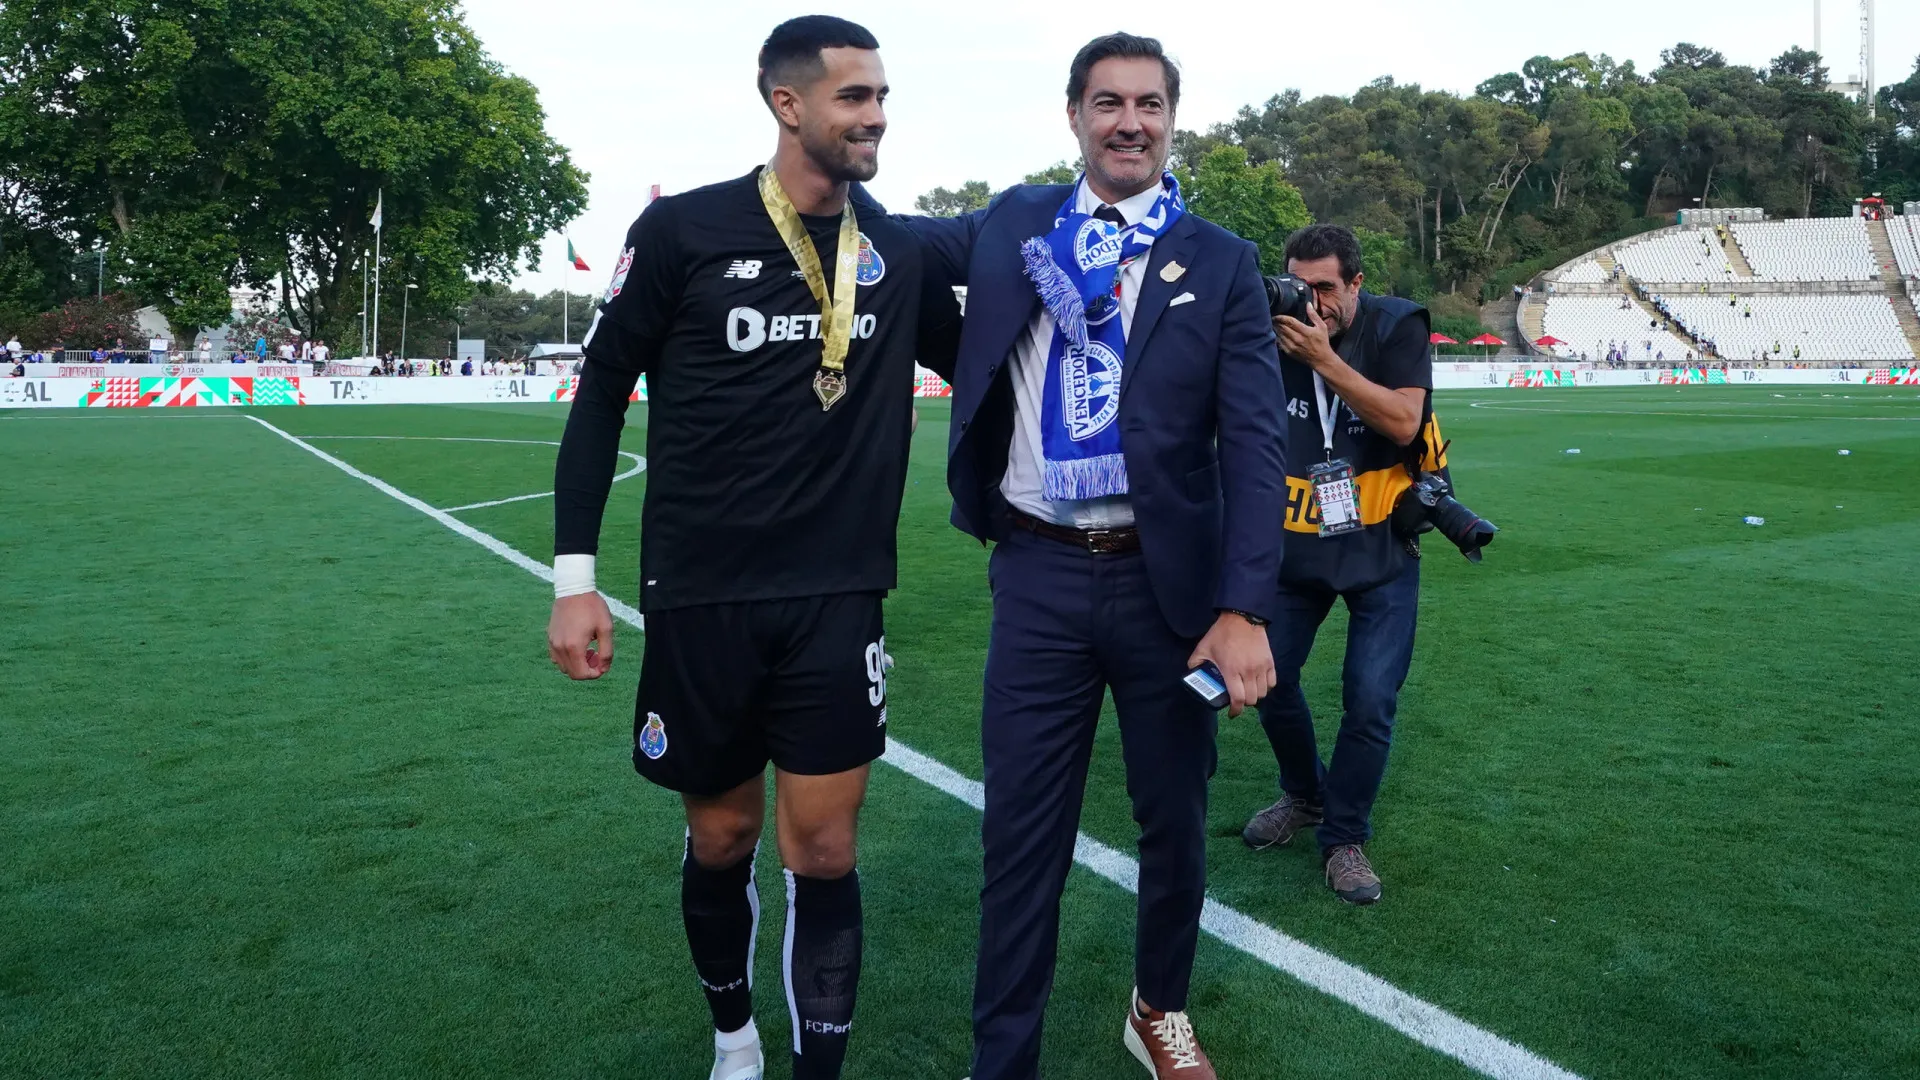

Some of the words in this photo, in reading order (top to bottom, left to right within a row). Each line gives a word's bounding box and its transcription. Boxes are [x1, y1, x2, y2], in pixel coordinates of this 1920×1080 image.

[768, 313, 877, 342] BETO
[1070, 345, 1088, 435] VENCEDOR
[1286, 397, 1309, 419] 45
[1347, 425, 1366, 435] FPF
[1323, 486, 1329, 494] 2
[1343, 481, 1349, 489] 5
